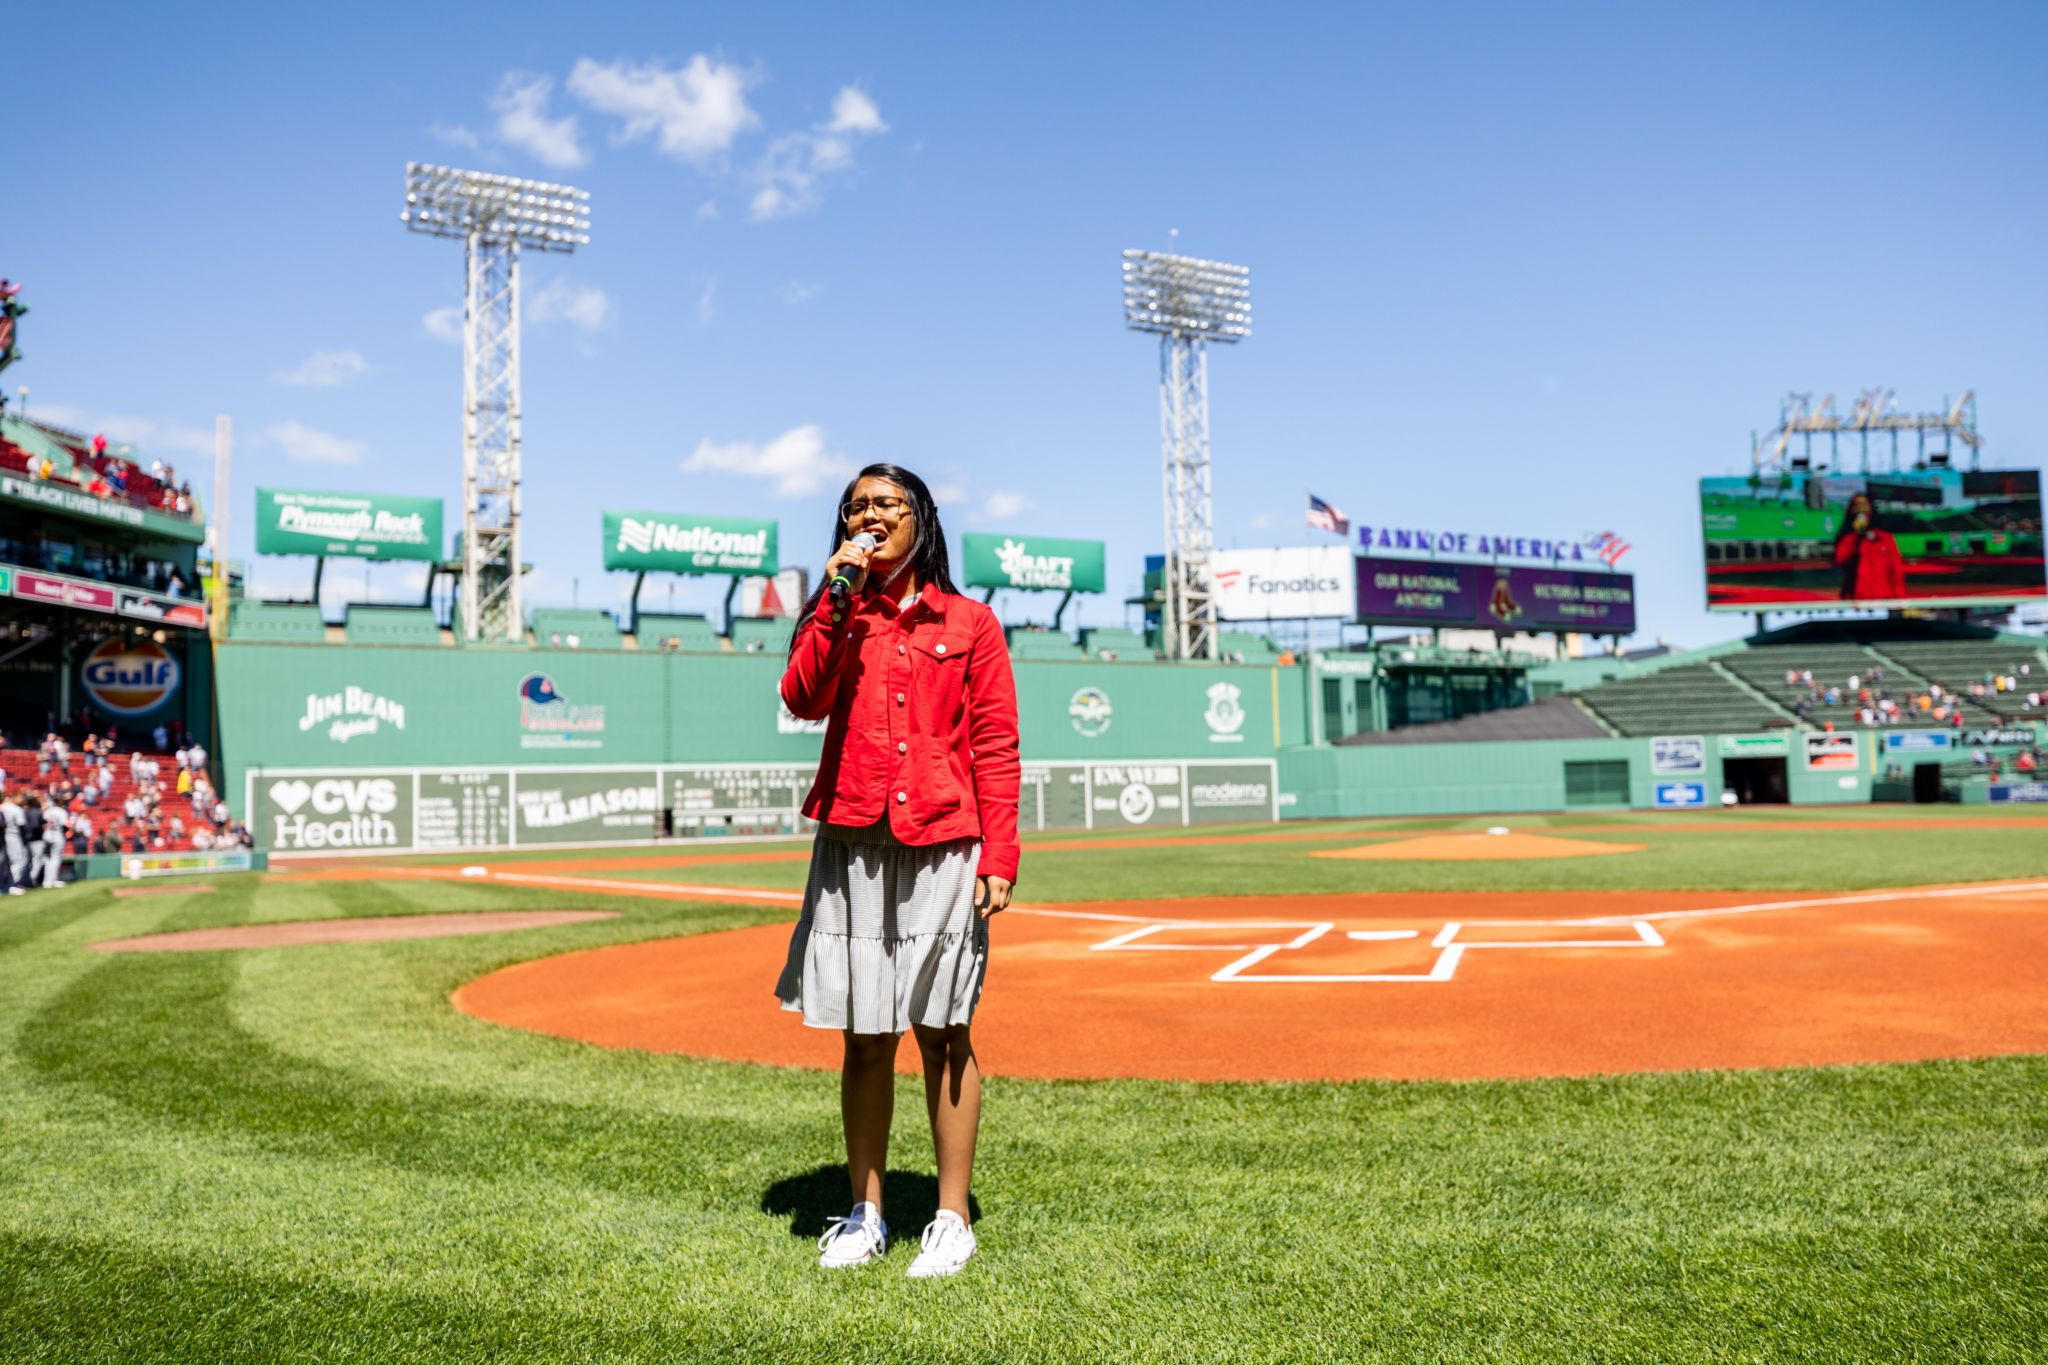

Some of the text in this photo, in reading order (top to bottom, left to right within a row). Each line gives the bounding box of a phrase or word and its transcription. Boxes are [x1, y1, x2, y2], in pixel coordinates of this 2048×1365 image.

[22, 484, 145, 525] BLACK LIVES MATTER
[279, 505, 424, 532] Plymouth Rock
[653, 523, 768, 556] National
[1358, 526, 1584, 562] BANK OF AMERICA
[1009, 570, 1074, 589] KINGS
[1248, 574, 1340, 594] Fanatics
[1374, 573, 1461, 593] OUR NATIONAL
[1533, 583, 1581, 600] VICTORIA
[1395, 592, 1445, 609] ANTHEM
[86, 659, 171, 686] Gulf
[298, 684, 405, 732] JIM BEAM
[311, 778, 397, 815] CVS
[1192, 783, 1267, 800] moderna
[273, 812, 398, 848] Health
